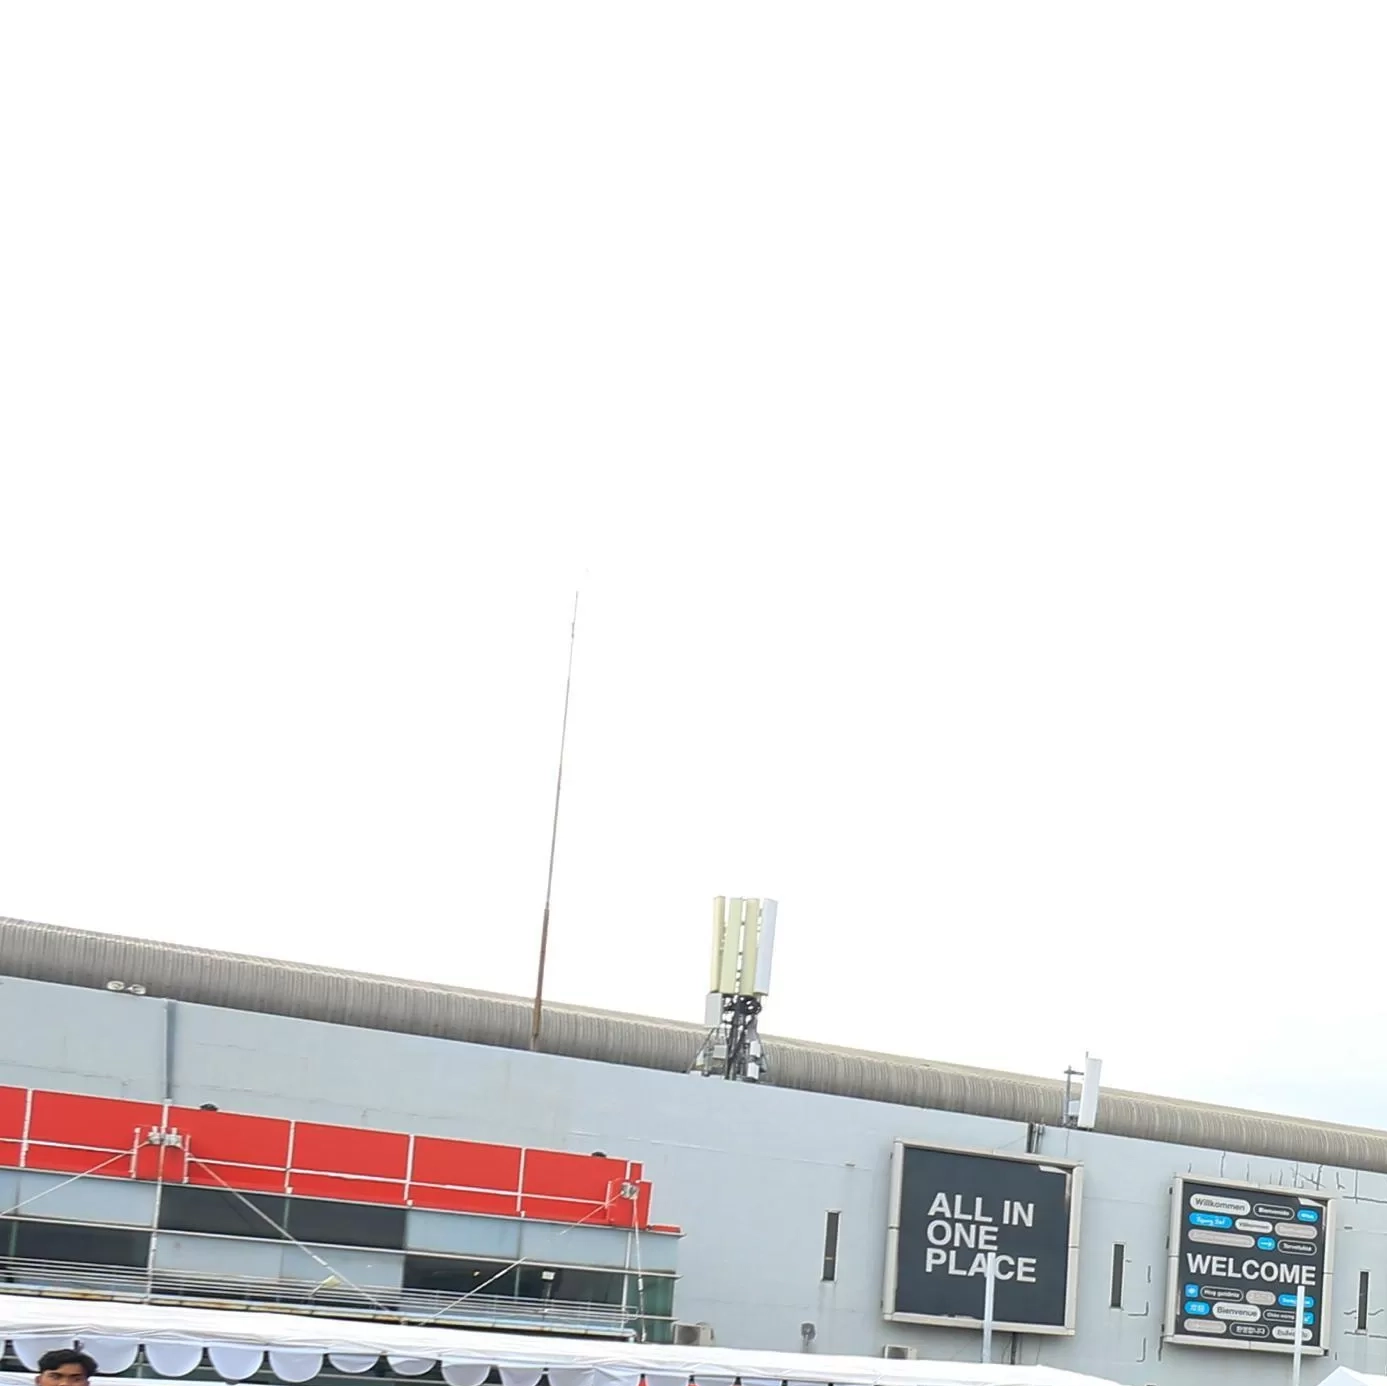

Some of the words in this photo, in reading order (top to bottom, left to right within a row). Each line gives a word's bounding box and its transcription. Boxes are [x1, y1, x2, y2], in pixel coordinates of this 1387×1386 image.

[927, 1192, 993, 1223] ALL
[1002, 1199, 1034, 1227] IN
[1195, 1197, 1246, 1212] Willkommen
[926, 1219, 999, 1251] ONE
[925, 1247, 1037, 1283] PLACE
[1186, 1252, 1317, 1286] WELCOME
[1216, 1305, 1258, 1318] Bienvenue
